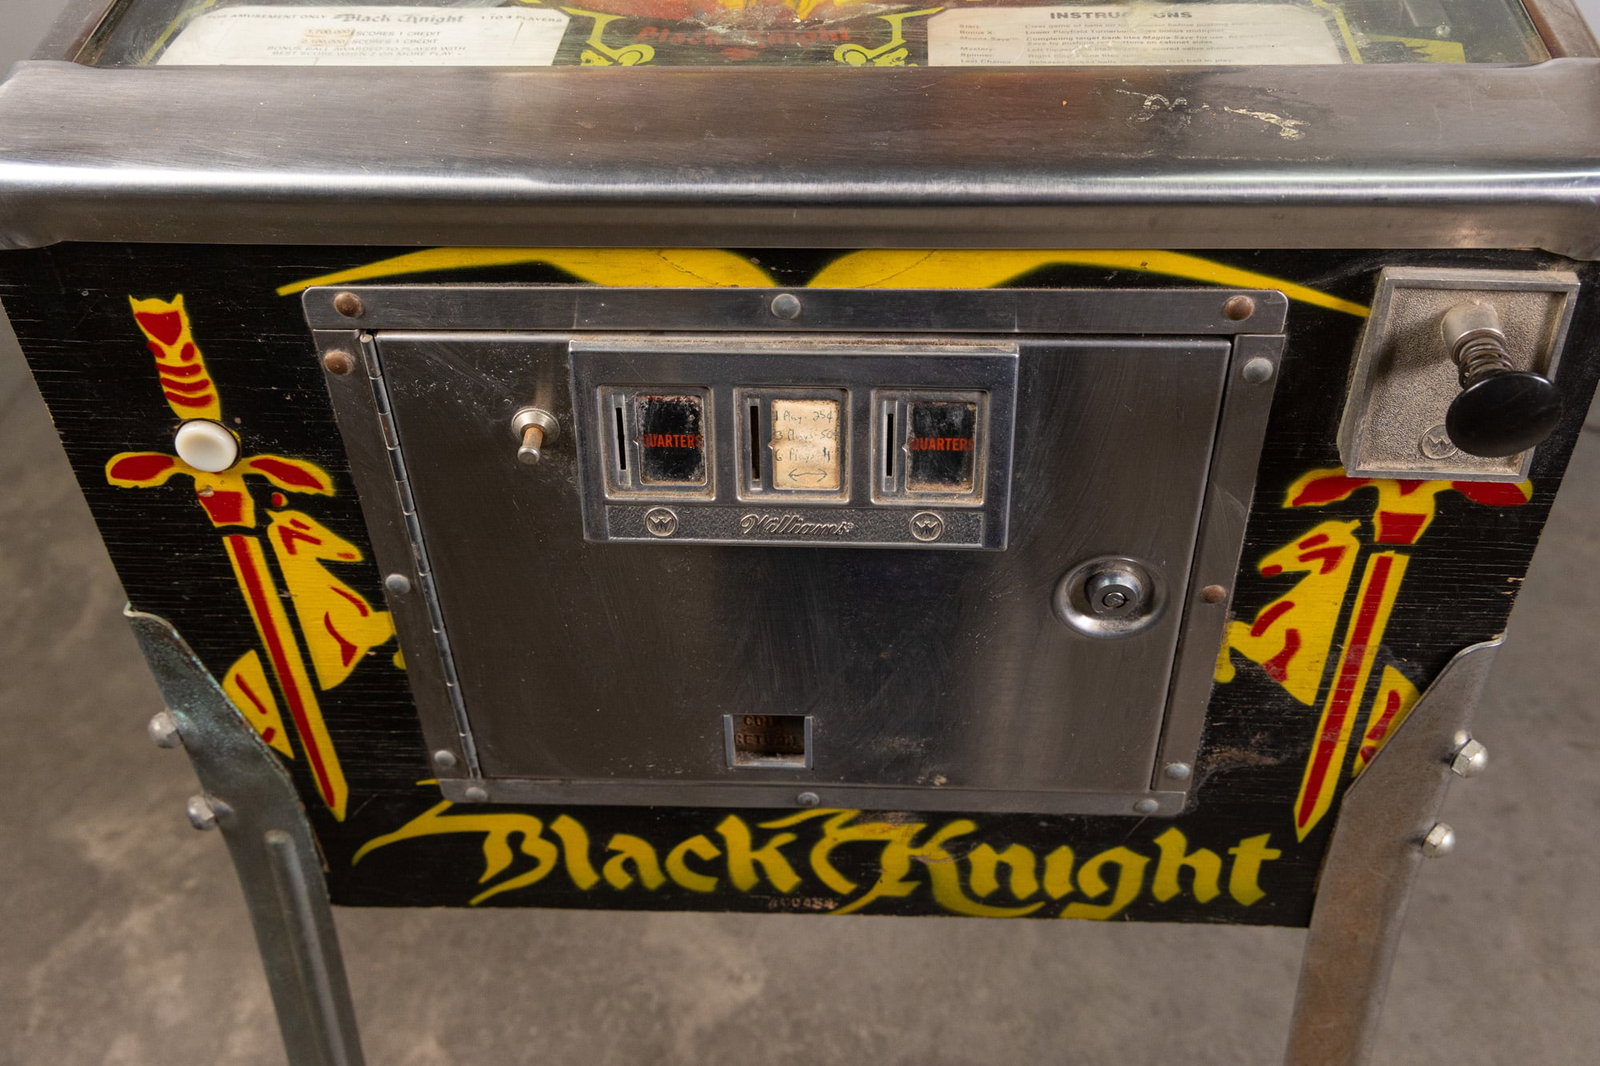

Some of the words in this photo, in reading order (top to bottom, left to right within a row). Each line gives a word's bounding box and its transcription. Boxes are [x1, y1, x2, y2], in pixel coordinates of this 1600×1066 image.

[333, 13, 391, 23] Black
[397, 13, 464, 26] Knight
[516, 15, 562, 23] PLAYERS
[773, 430, 784, 441] 3
[352, 800, 802, 907] Black
[758, 808, 1281, 922] Knight
